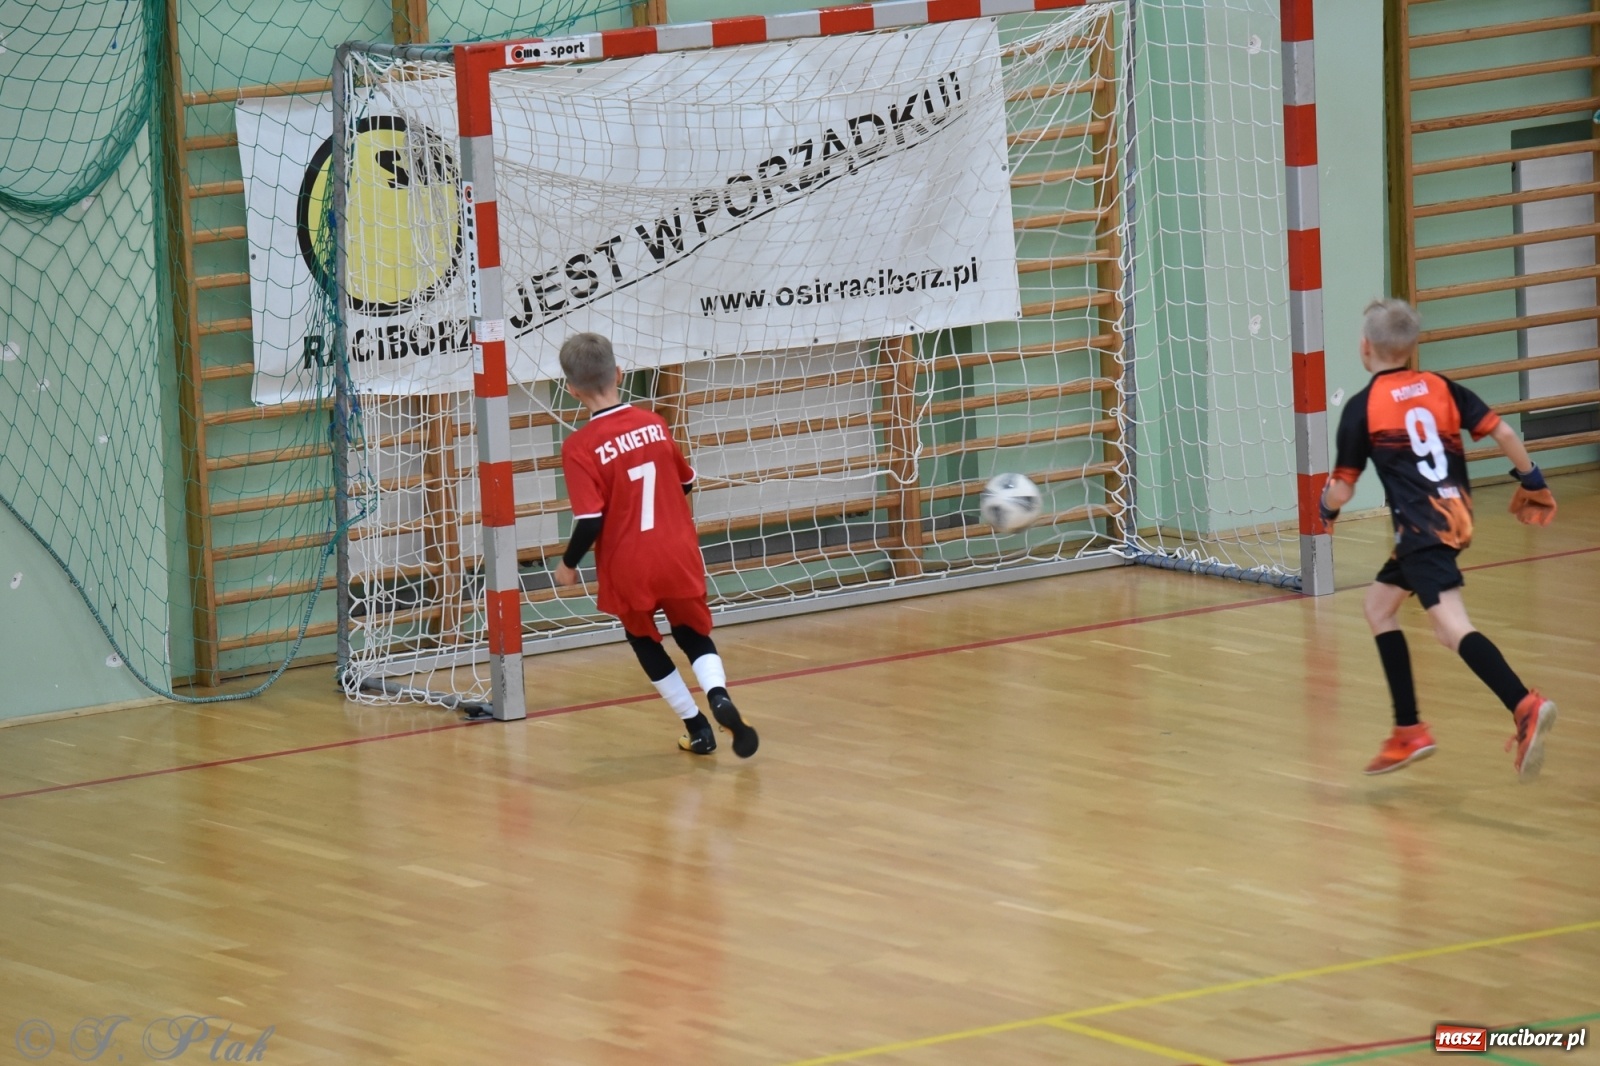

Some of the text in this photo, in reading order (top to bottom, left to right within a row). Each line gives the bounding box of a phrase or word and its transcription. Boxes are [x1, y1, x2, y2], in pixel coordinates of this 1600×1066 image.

[550, 41, 585, 58] sport
[469, 252, 478, 314] sport
[509, 235, 623, 329] JEST
[634, 207, 684, 263] W
[699, 256, 978, 317] www.osir-raciborz.pl
[594, 424, 667, 466] ZS KIETRZ
[1404, 406, 1448, 482] 9
[627, 461, 657, 532] 7
